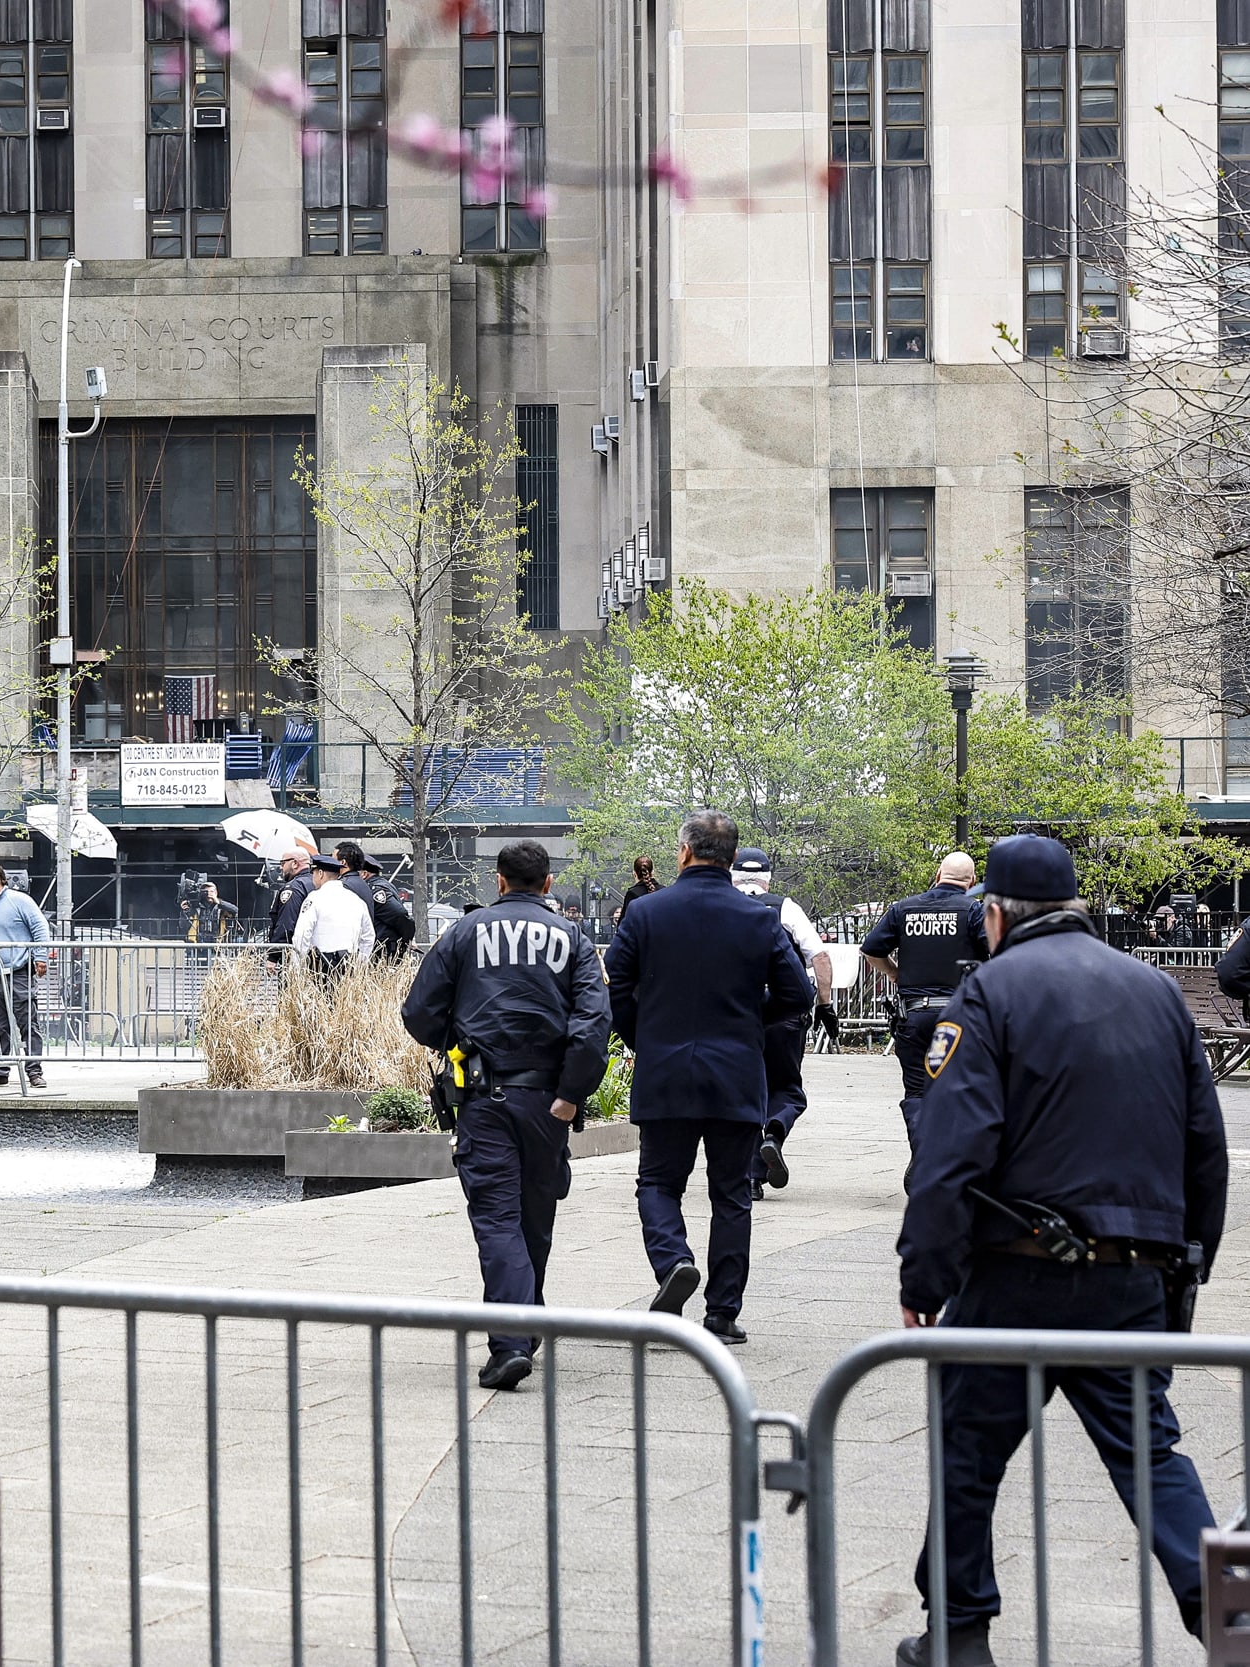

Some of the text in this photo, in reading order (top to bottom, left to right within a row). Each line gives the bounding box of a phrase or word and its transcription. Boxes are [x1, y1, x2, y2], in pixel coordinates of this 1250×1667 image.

[39, 316, 335, 343] CRIMINAL COURTS
[113, 346, 266, 372] BUILDING
[123, 747, 132, 760] 100
[134, 747, 155, 760] CENTRE
[165, 746, 178, 759] NEW
[196, 746, 204, 759] NY
[205, 746, 219, 759] 10013
[137, 768, 219, 777] J&N Construction
[137, 785, 207, 795] 718-845-0123
[905, 912, 958, 921] NEW YORK STATE
[905, 920, 957, 936] COURTS
[476, 920, 570, 974] NYPD
